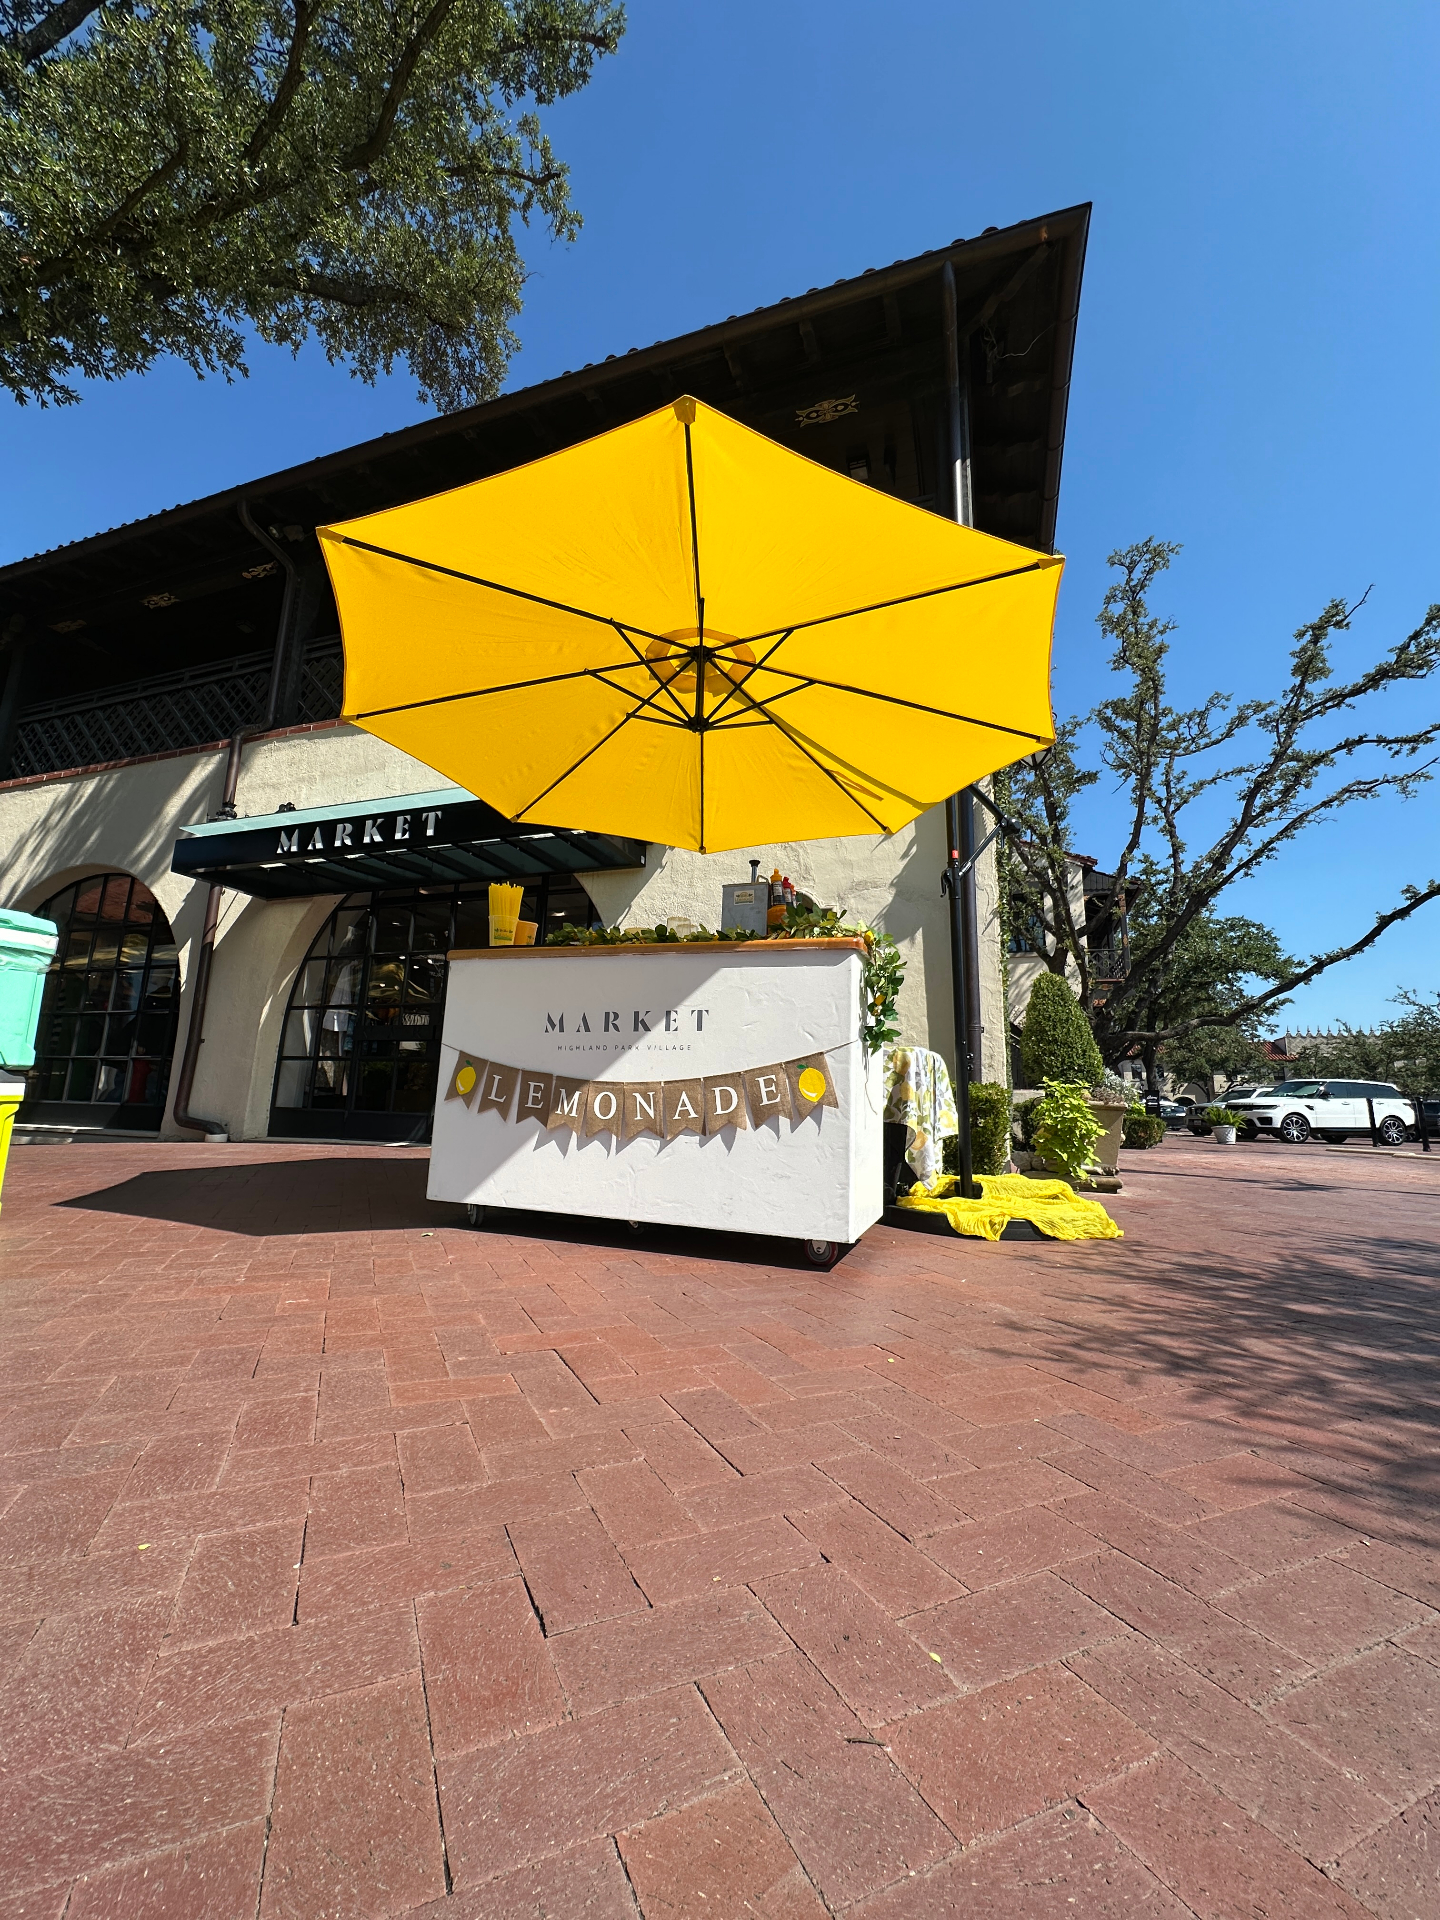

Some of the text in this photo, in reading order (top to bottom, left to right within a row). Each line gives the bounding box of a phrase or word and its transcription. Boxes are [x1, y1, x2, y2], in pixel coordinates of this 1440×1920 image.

[276, 810, 442, 854] MARKET
[544, 1009, 710, 1034] MARKET
[557, 1044, 608, 1052] HIGHLAND
[614, 1044, 640, 1052] PARK
[487, 1074, 782, 1121] LEMONADE
